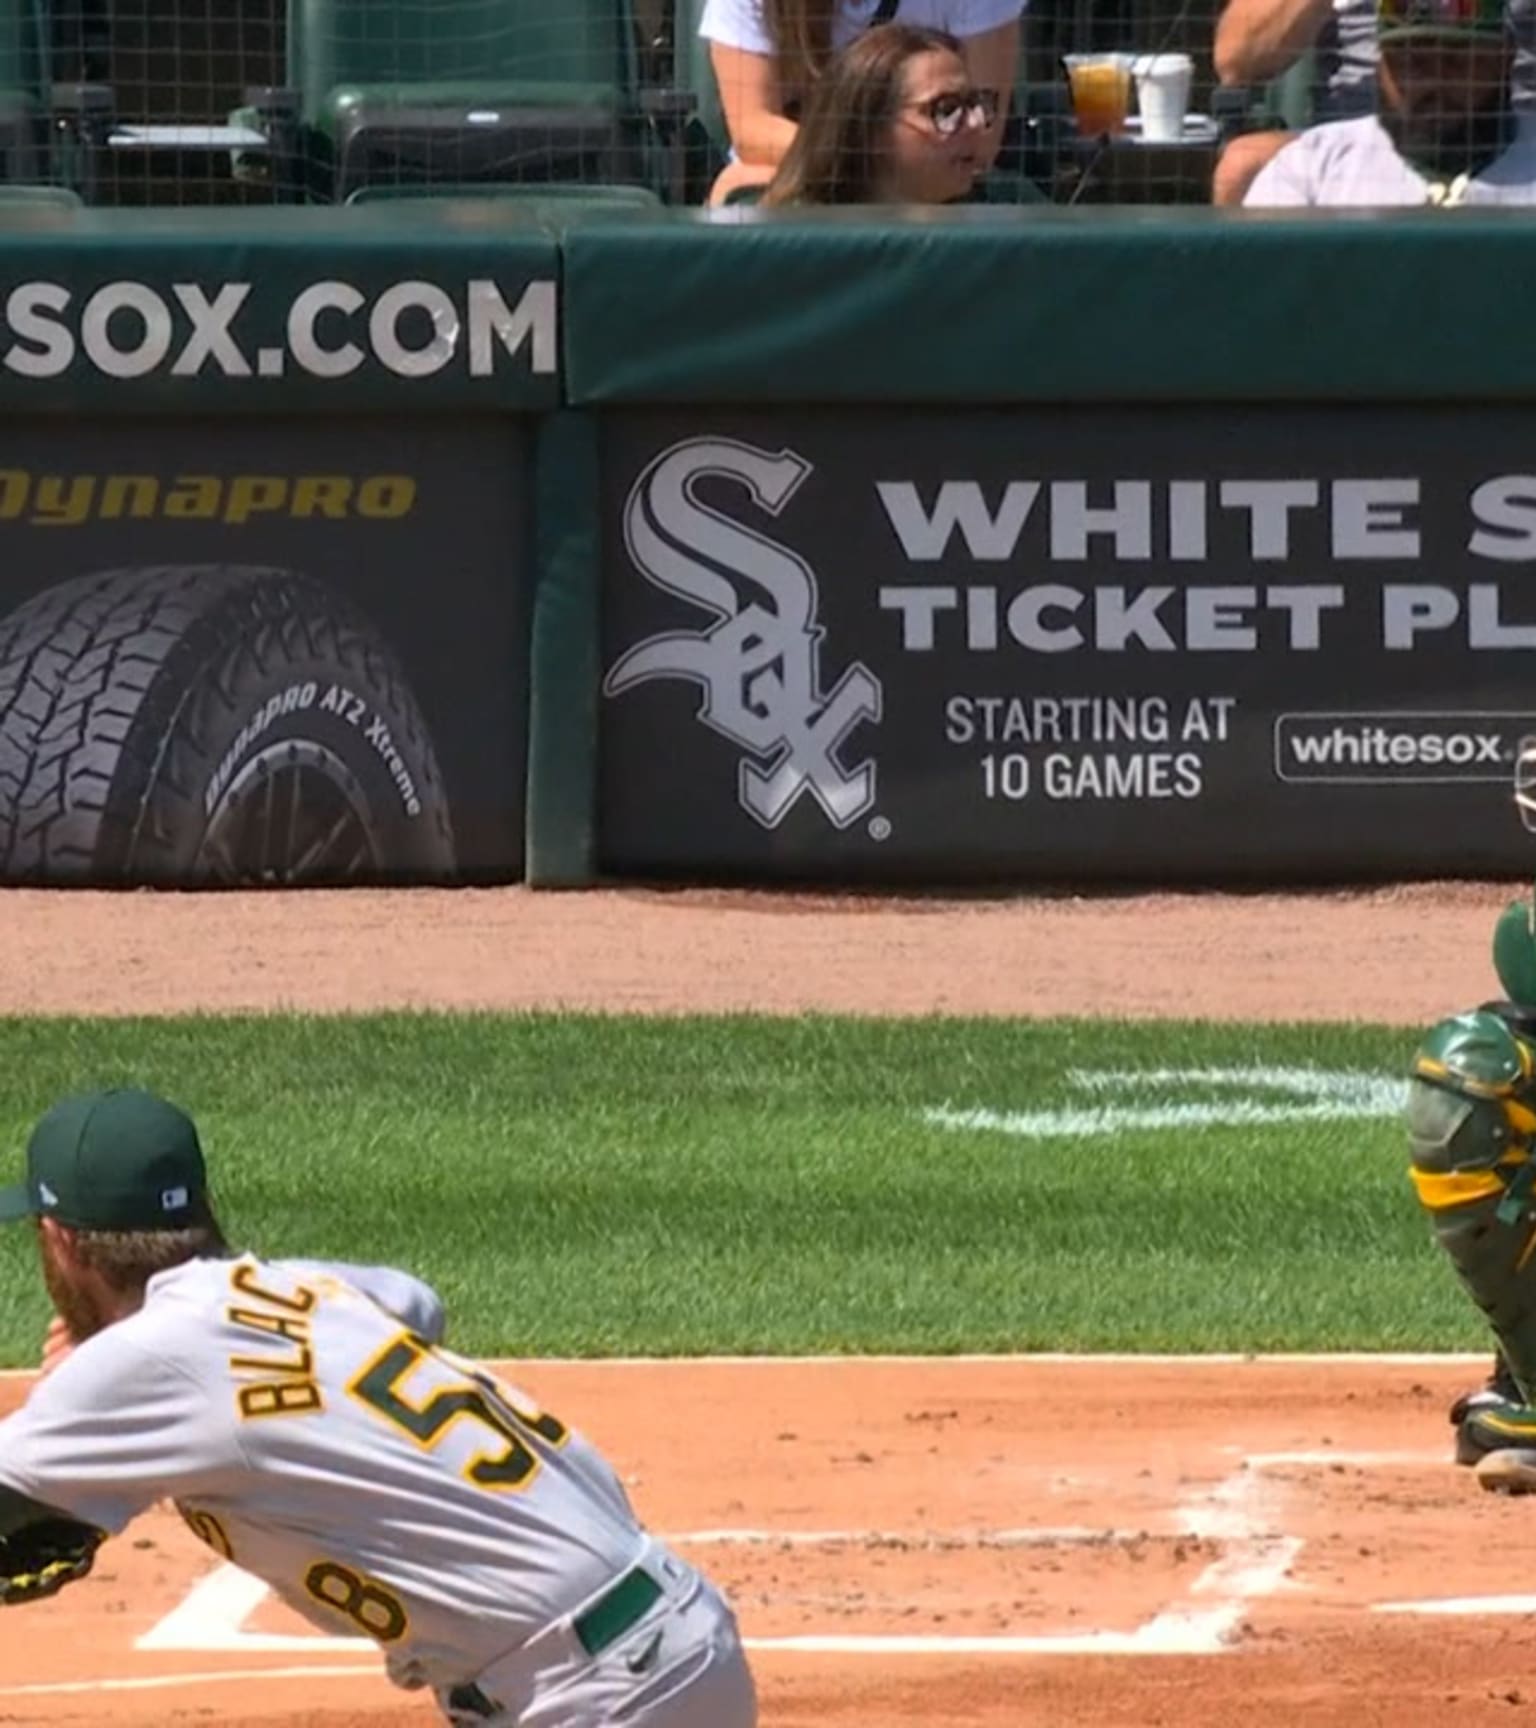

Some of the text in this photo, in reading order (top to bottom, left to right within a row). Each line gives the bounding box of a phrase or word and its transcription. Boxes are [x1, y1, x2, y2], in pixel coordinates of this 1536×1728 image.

[3, 279, 557, 378] SOX.COM
[875, 478, 1421, 561] WHITE
[879, 583, 1345, 653] TICKET
[319, 685, 367, 726] AT2
[363, 714, 422, 817] Xtreme
[945, 696, 1237, 744] STARTING AT
[981, 752, 1203, 800] 10 GAMES
